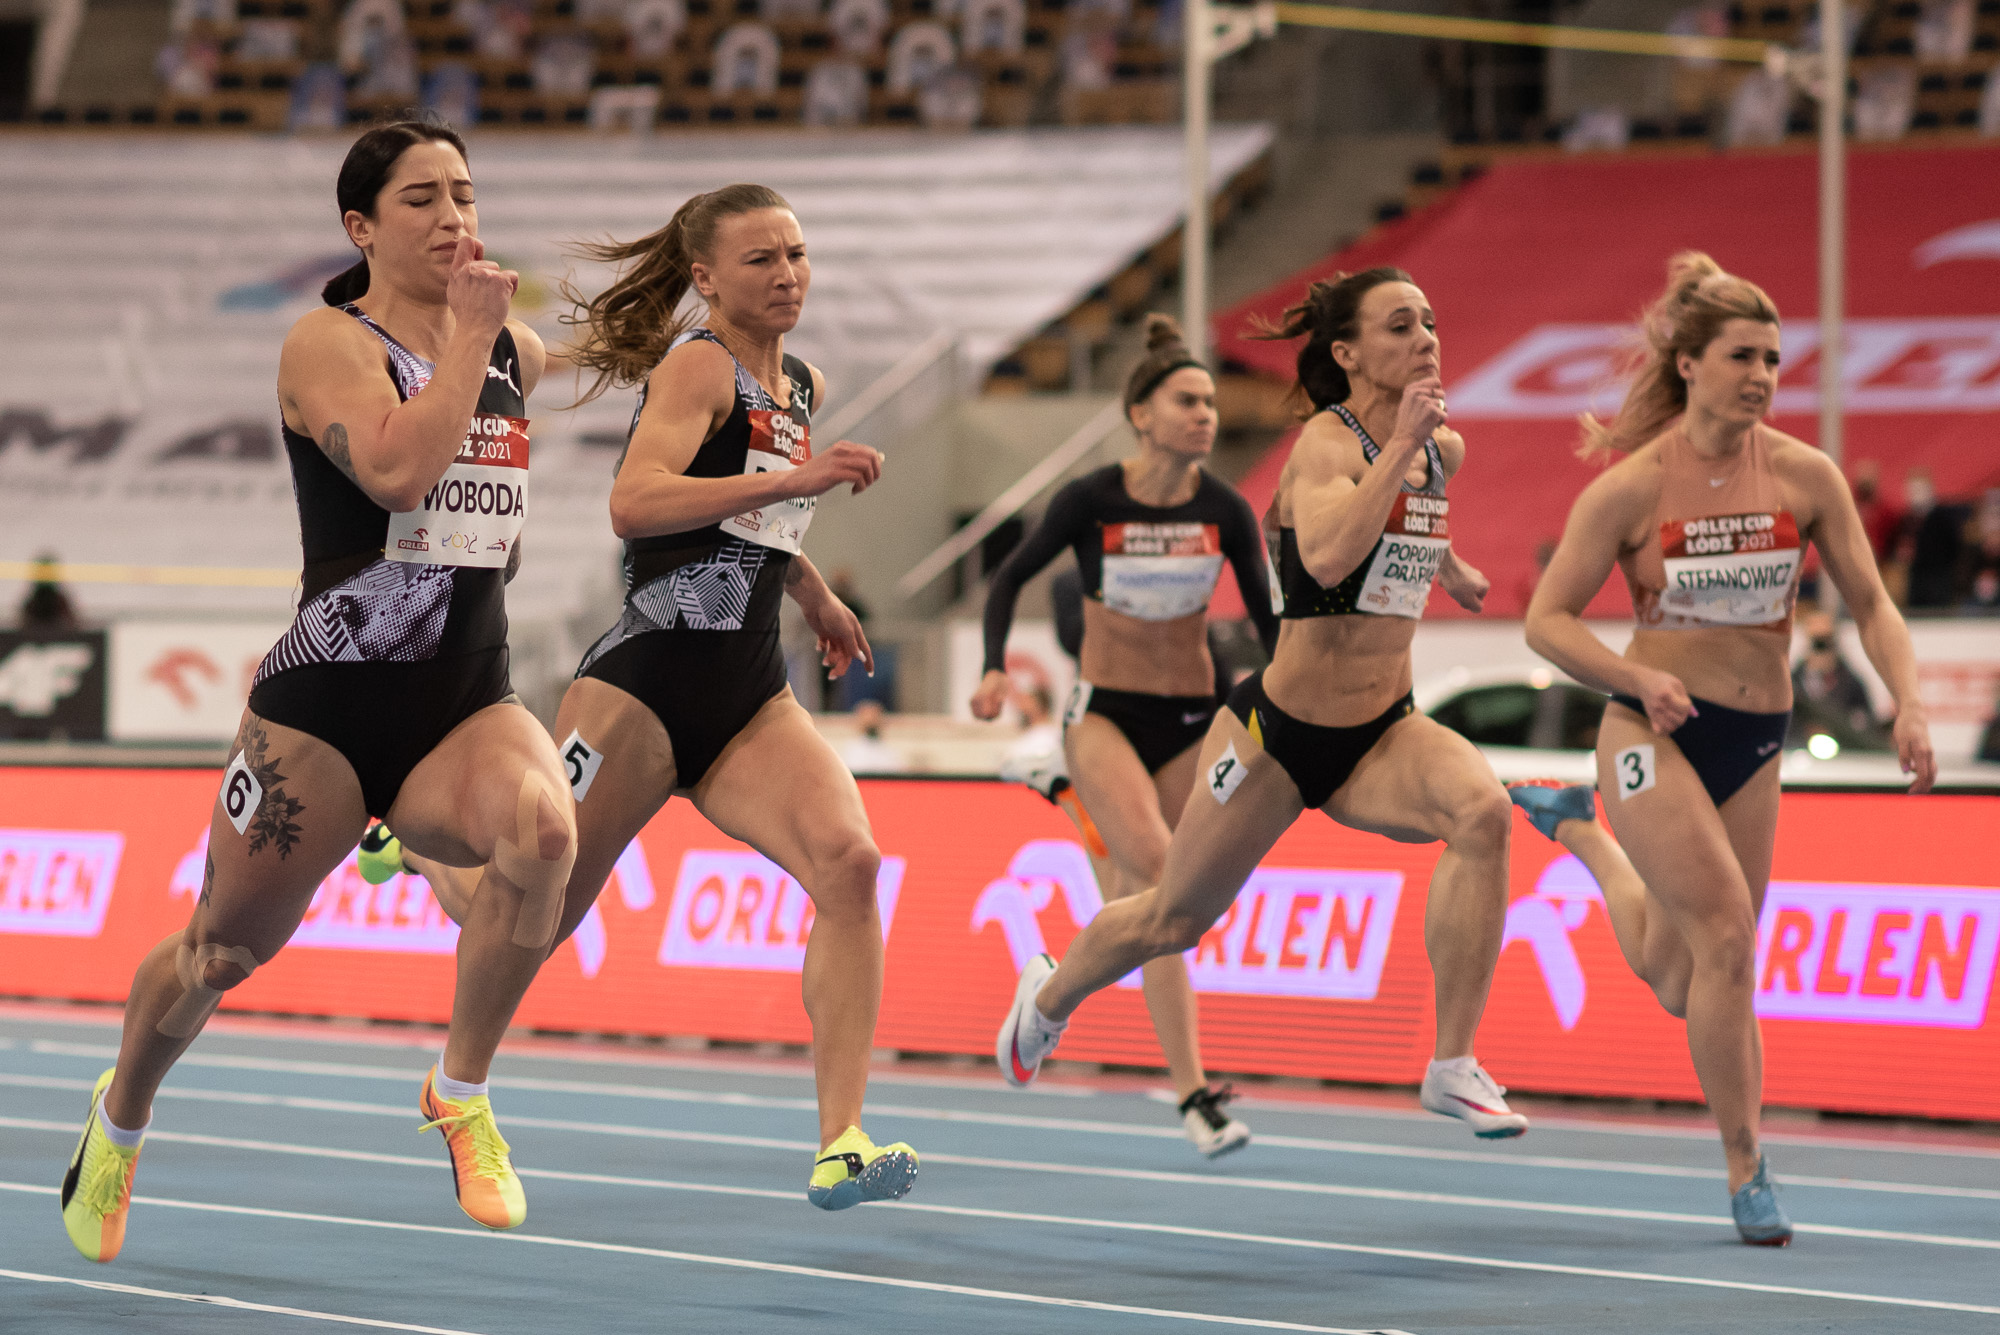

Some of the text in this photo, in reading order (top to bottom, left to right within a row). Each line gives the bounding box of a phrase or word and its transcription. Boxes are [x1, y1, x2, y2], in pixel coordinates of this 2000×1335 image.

[483, 418, 511, 437] CUP
[478, 440, 511, 460] 2021
[735, 516, 760, 531] ORLEN
[1684, 514, 1775, 537] ORLEN CUP
[399, 540, 428, 551] ORLEN
[1686, 532, 1775, 554] ŁÓDŹ 2021
[1676, 562, 1793, 591] STEFANOWICZ
[564, 740, 591, 788] 5
[1213, 758, 1236, 790] 4
[1623, 751, 1645, 791] 3
[226, 769, 252, 818] 6
[1757, 908, 1980, 1000] RLEN
